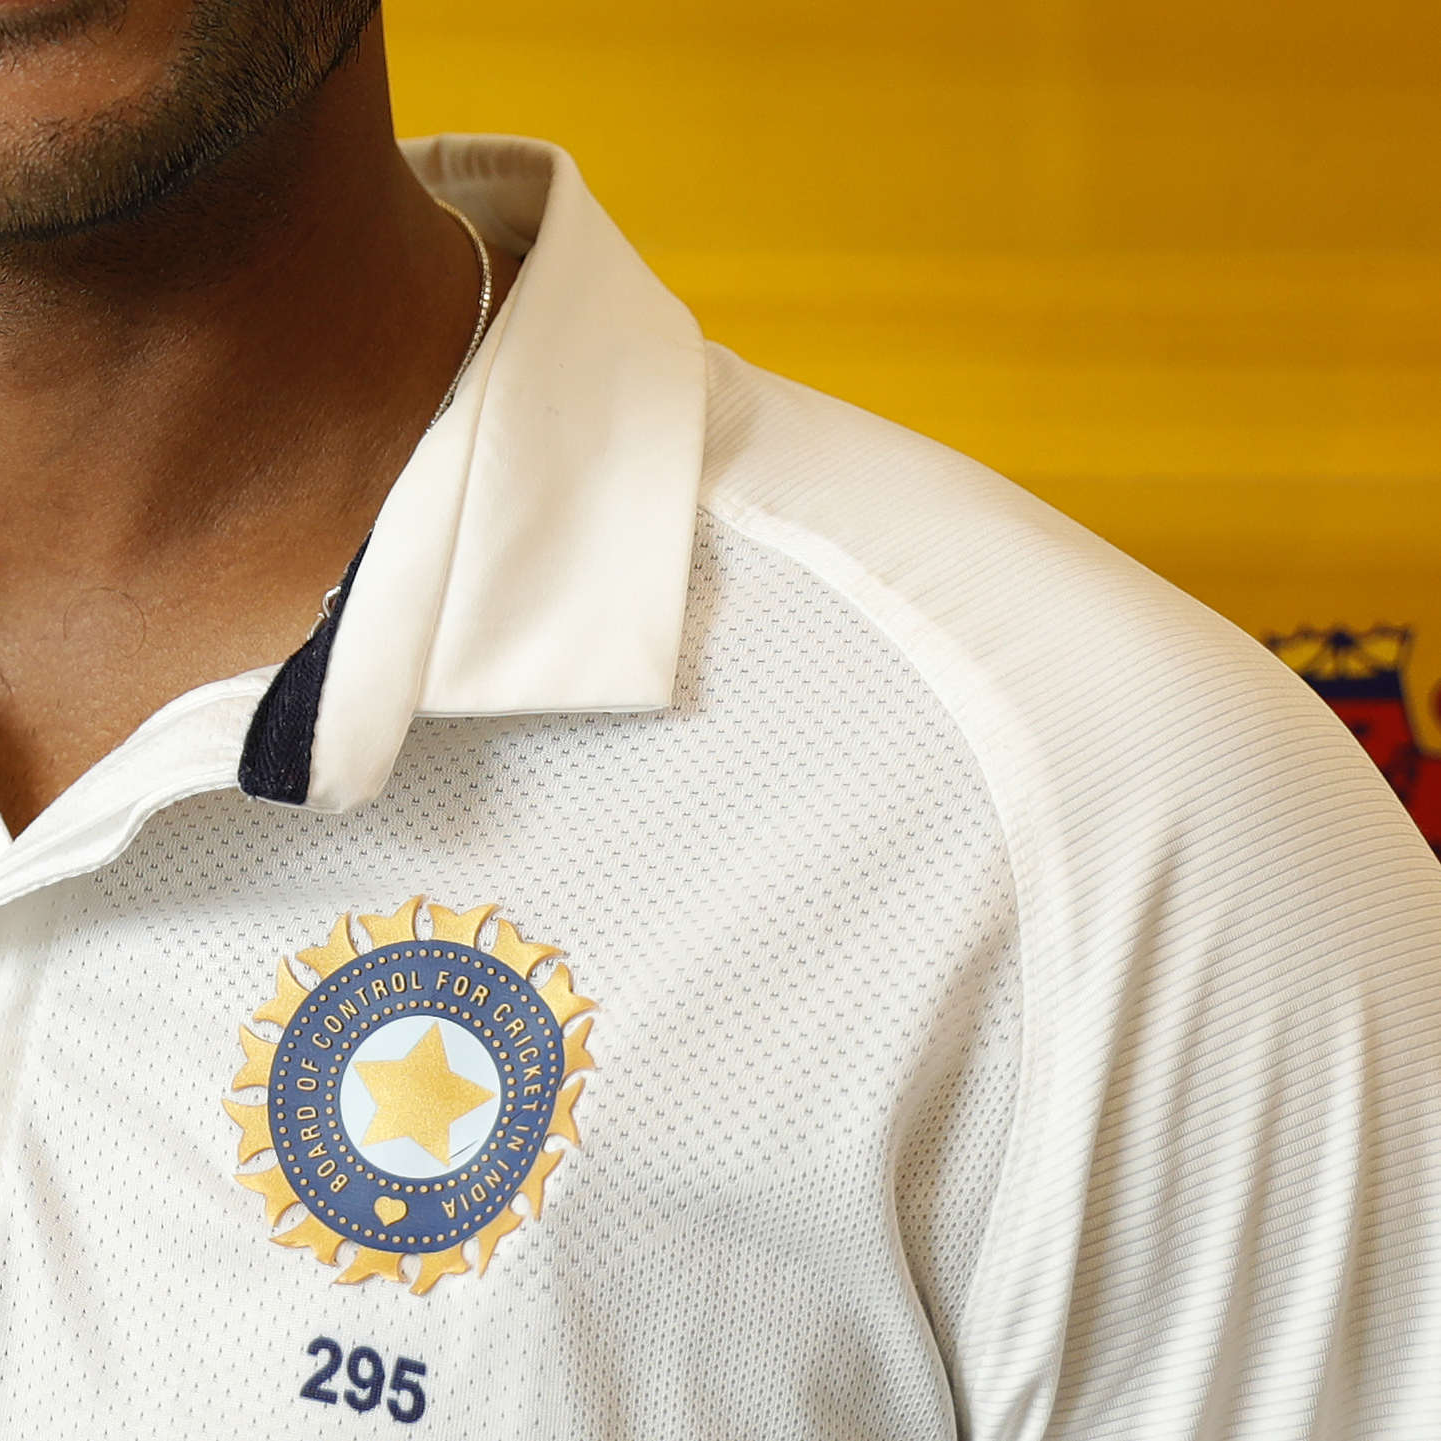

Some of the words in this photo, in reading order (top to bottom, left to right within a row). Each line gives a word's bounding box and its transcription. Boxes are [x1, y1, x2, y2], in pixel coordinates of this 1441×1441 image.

[312, 971, 423, 1049] CONTROL
[436, 971, 490, 1006] FOR
[297, 1058, 320, 1091] OF
[493, 1003, 543, 1112] CRICKET
[297, 1106, 349, 1193] BOARD
[507, 1125, 530, 1152] IN
[441, 1160, 510, 1219] INDIA
[300, 1335, 427, 1424] 295
